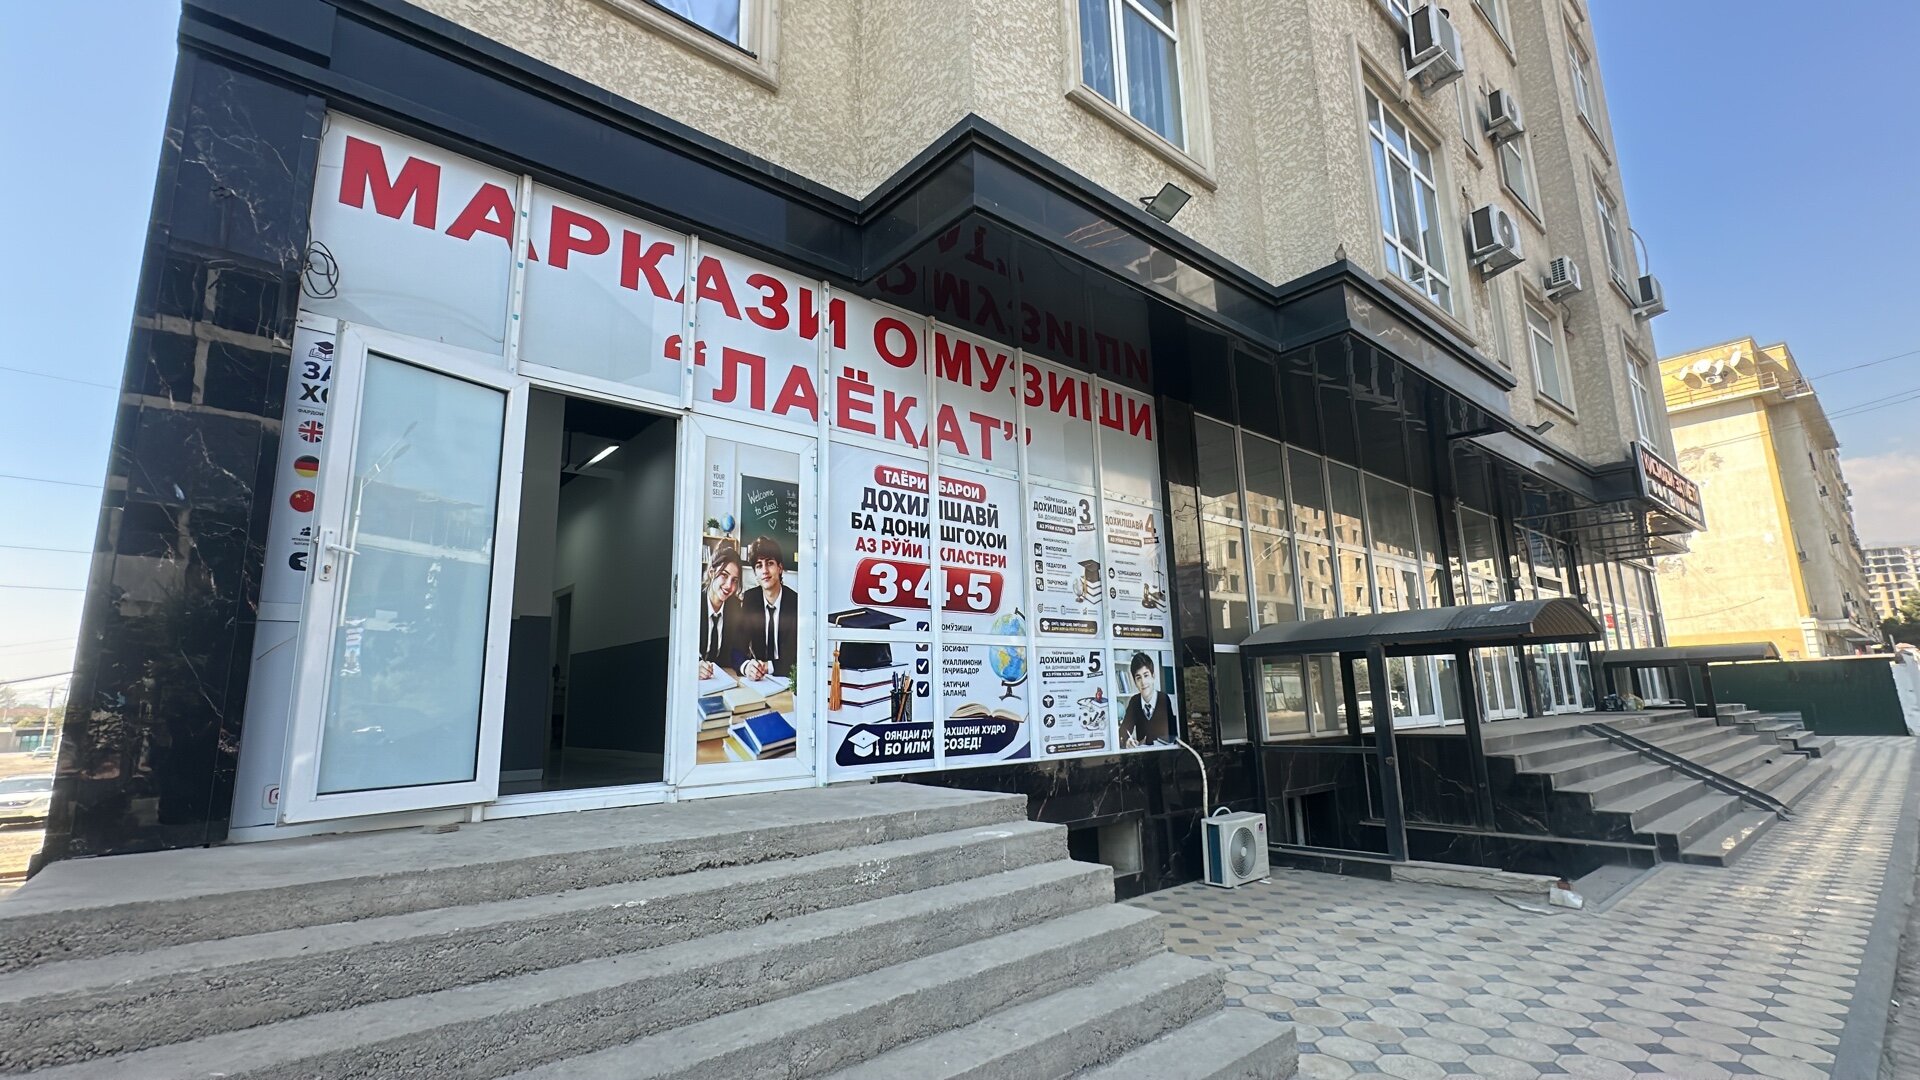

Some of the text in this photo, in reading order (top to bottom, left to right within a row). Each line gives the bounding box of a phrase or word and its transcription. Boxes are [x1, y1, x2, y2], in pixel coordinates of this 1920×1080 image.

[338, 135, 1153, 441] МАРКАЗИ ОМУЗИШИ
[883, 470, 980, 499] ТАЁРИ БАРОИ
[747, 489, 774, 504] Welcome
[755, 506, 761, 516] to
[763, 498, 779, 513] class!
[1079, 499, 1091, 524] 3
[851, 512, 1007, 550] БА ДОНИШГОҲОИ
[1145, 513, 1156, 537] 4
[855, 536, 877, 553] АЗ
[1088, 651, 1101, 673] 5
[884, 729, 920, 741] ОЯНДАИ
[981, 724, 1006, 735] ХУДРО
[884, 742, 901, 756] БО
[904, 741, 931, 754] ИЛМ
